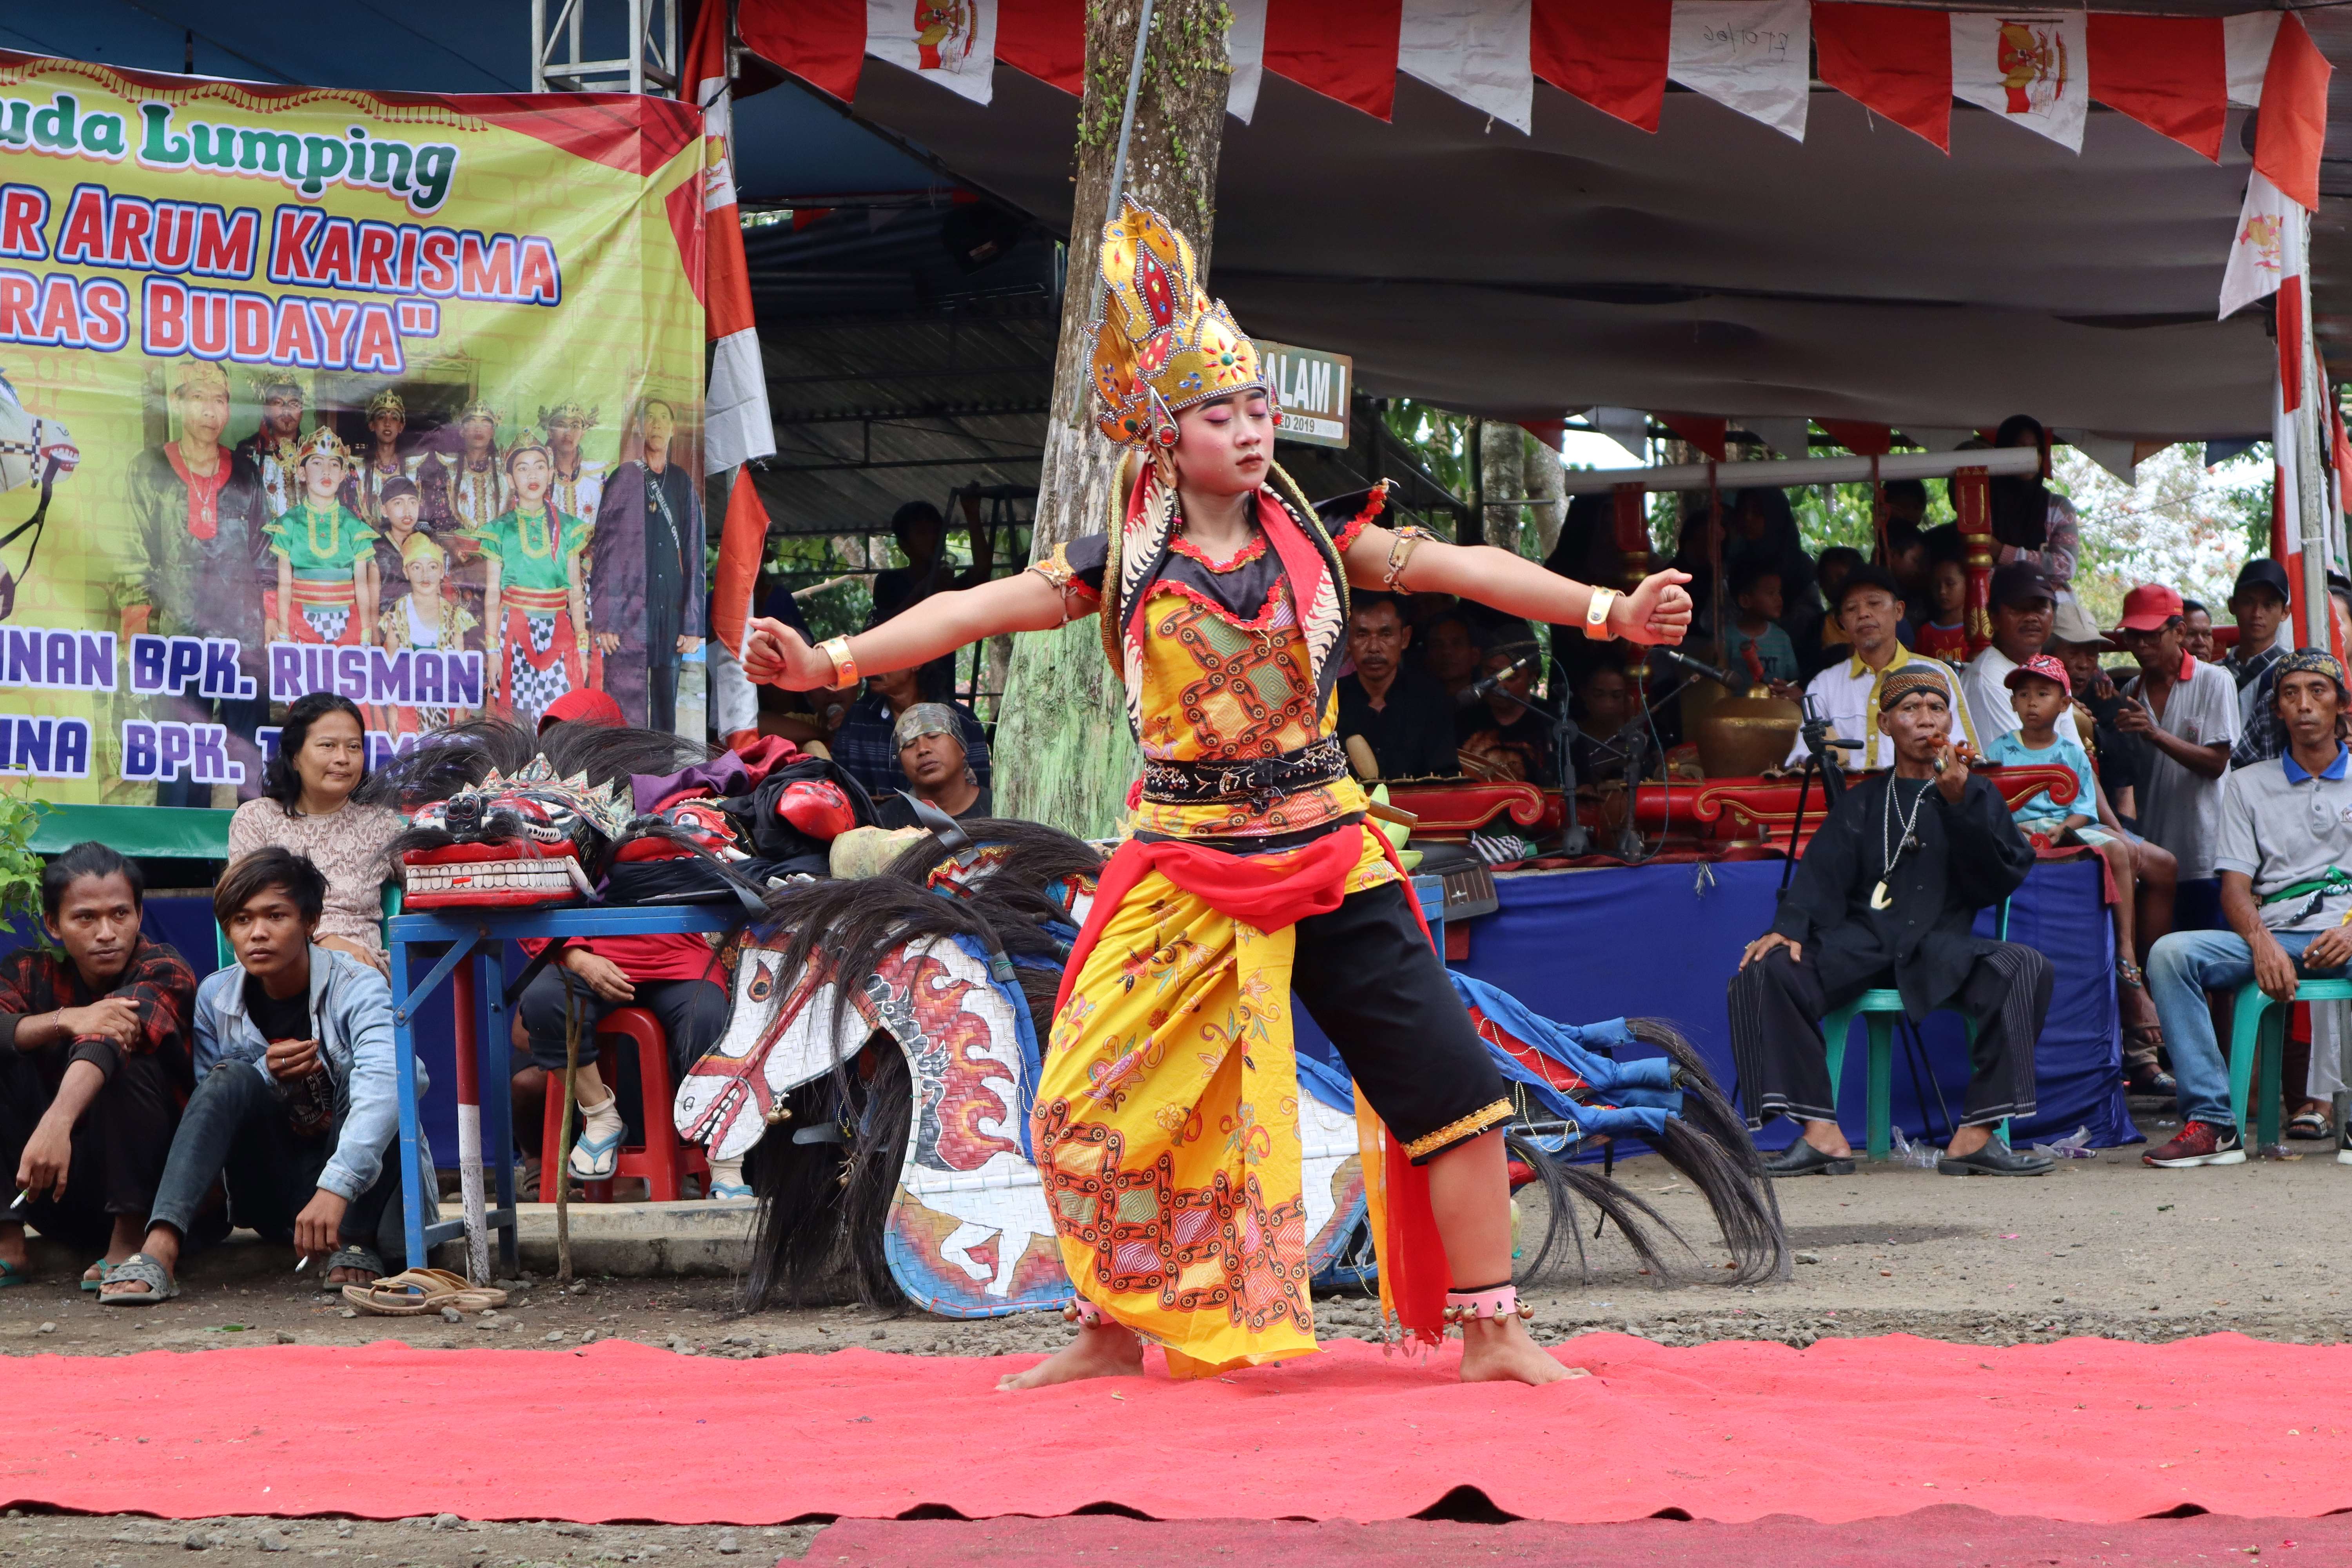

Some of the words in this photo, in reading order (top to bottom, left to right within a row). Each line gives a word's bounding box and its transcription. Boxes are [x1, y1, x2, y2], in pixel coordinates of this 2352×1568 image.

[0, 95, 125, 154] uda
[140, 103, 456, 209] Lumping
[2, 192, 41, 252] R
[63, 192, 253, 272] ARUM
[274, 213, 557, 301] KARISMA
[0, 278, 121, 343] RAS
[149, 284, 435, 368] BUDAYA"
[1294, 416, 1315, 433] 2019
[134, 638, 252, 695] BPK.
[273, 647, 479, 704] RUSMAN
[125, 724, 242, 780] BPK.
